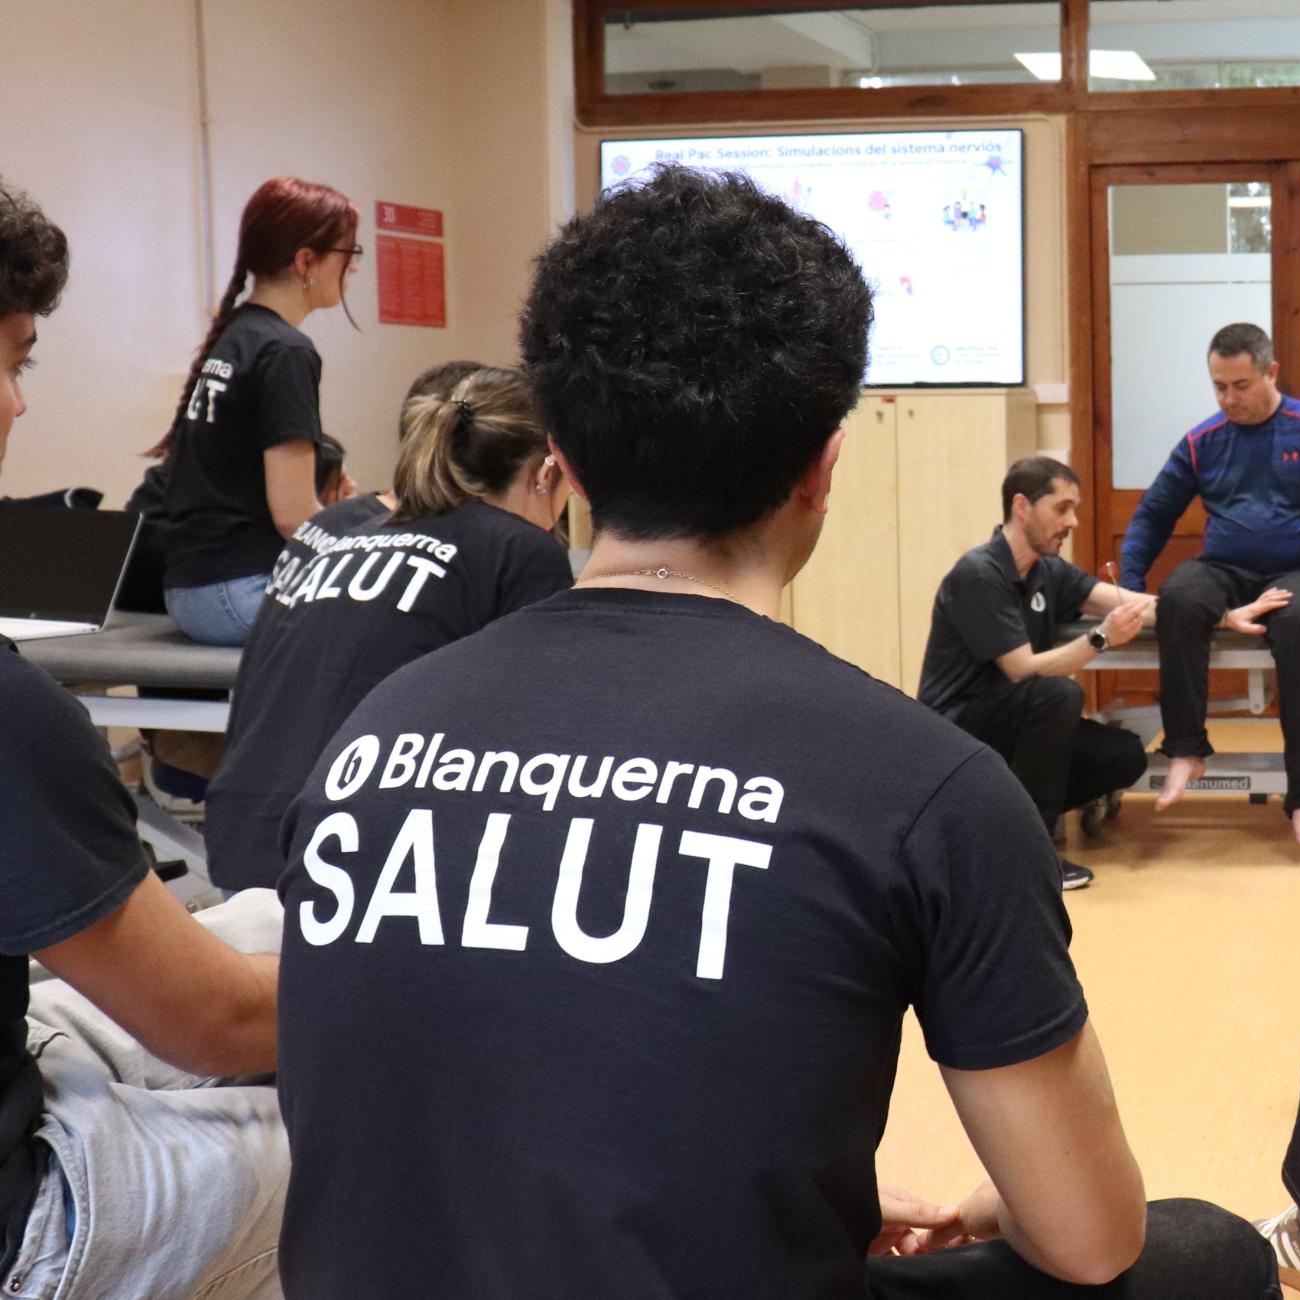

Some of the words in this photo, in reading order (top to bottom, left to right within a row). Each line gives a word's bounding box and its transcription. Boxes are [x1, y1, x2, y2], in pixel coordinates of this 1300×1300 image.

[688, 148, 712, 159] Pac
[777, 144, 861, 157] Simulacions
[865, 143, 887, 155] del
[891, 142, 945, 154] sistema
[378, 732, 785, 823] Blanquerna
[299, 808, 773, 980] SALUT
